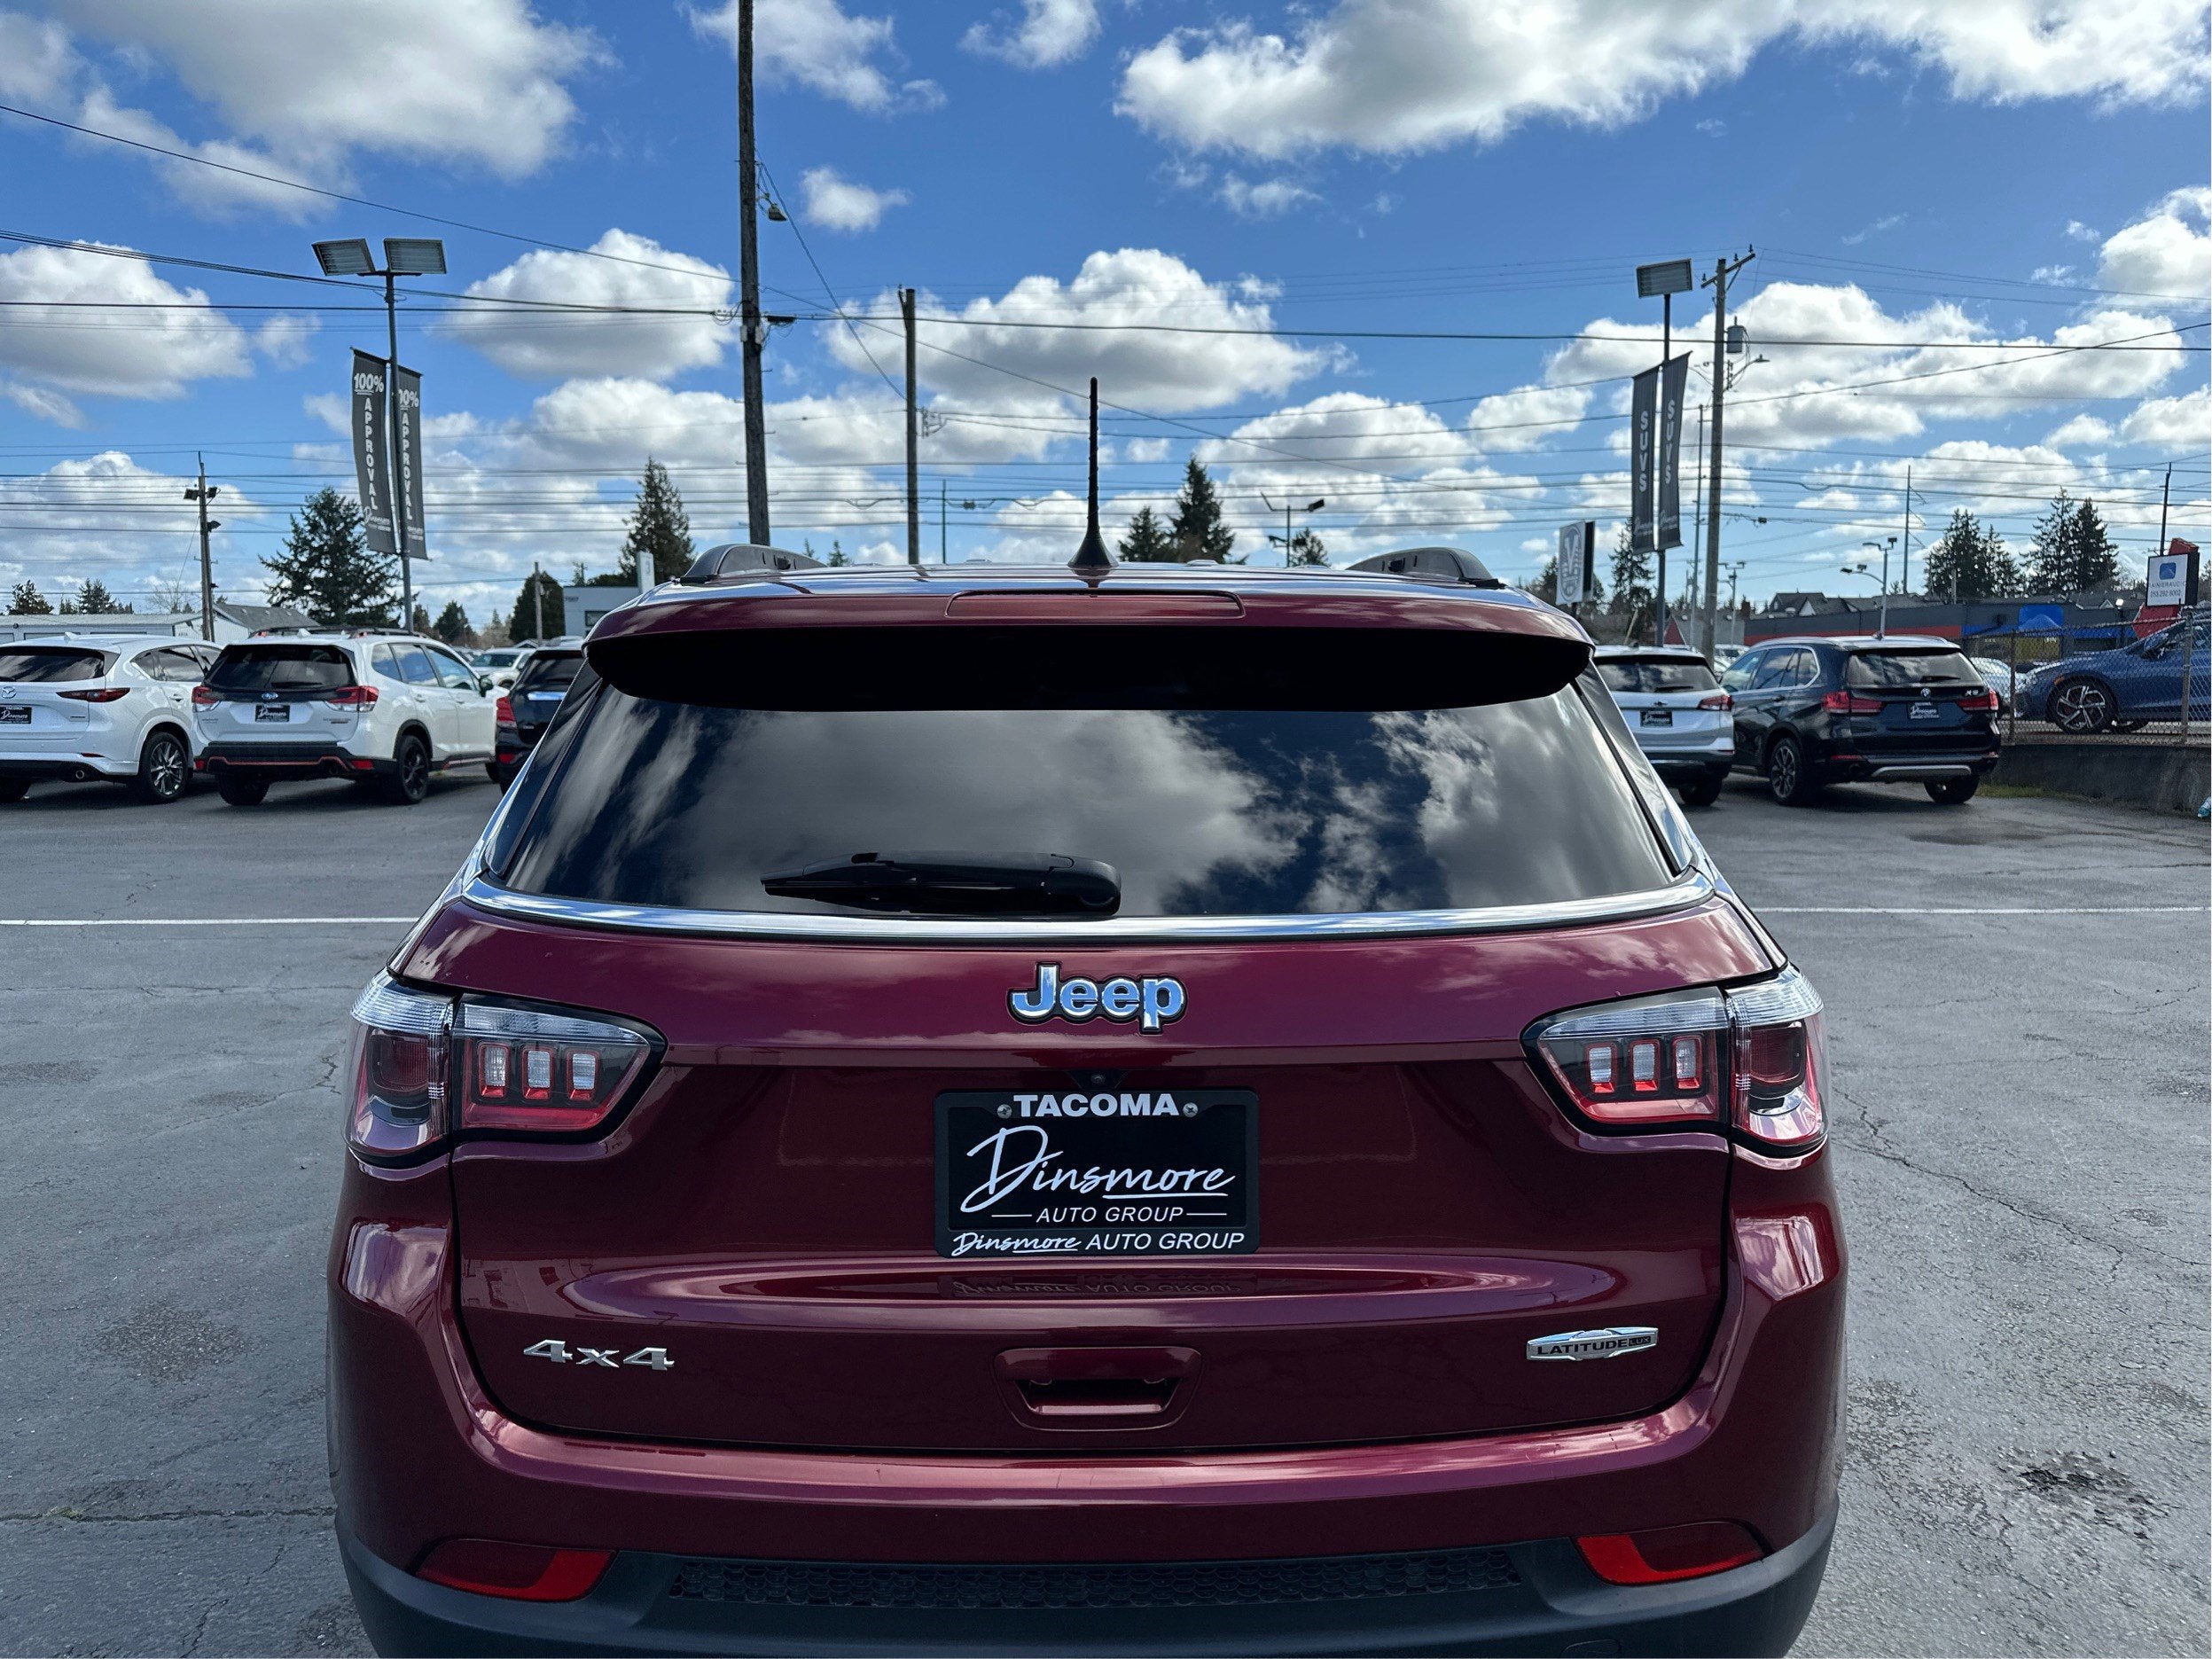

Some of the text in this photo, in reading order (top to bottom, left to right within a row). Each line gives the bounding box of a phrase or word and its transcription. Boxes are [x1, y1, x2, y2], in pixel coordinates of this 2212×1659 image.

[354, 372, 385, 393] 100%
[364, 397, 379, 511] APPROVAL
[402, 412, 413, 520] APPROVAL
[1638, 411, 1649, 493] SUVS
[1665, 399, 1676, 485] SUVS
[1010, 963, 1185, 1029] Jeep
[1013, 1093, 1180, 1117] TACOMA
[960, 1125, 1236, 1213] Dinsmore
[951, 1233, 1245, 1256] Dinsmore AUTO GROUP
[1036, 1207, 1184, 1223] AUTO GROUP
[1537, 1335, 1652, 1355] LATITUDE LUX
